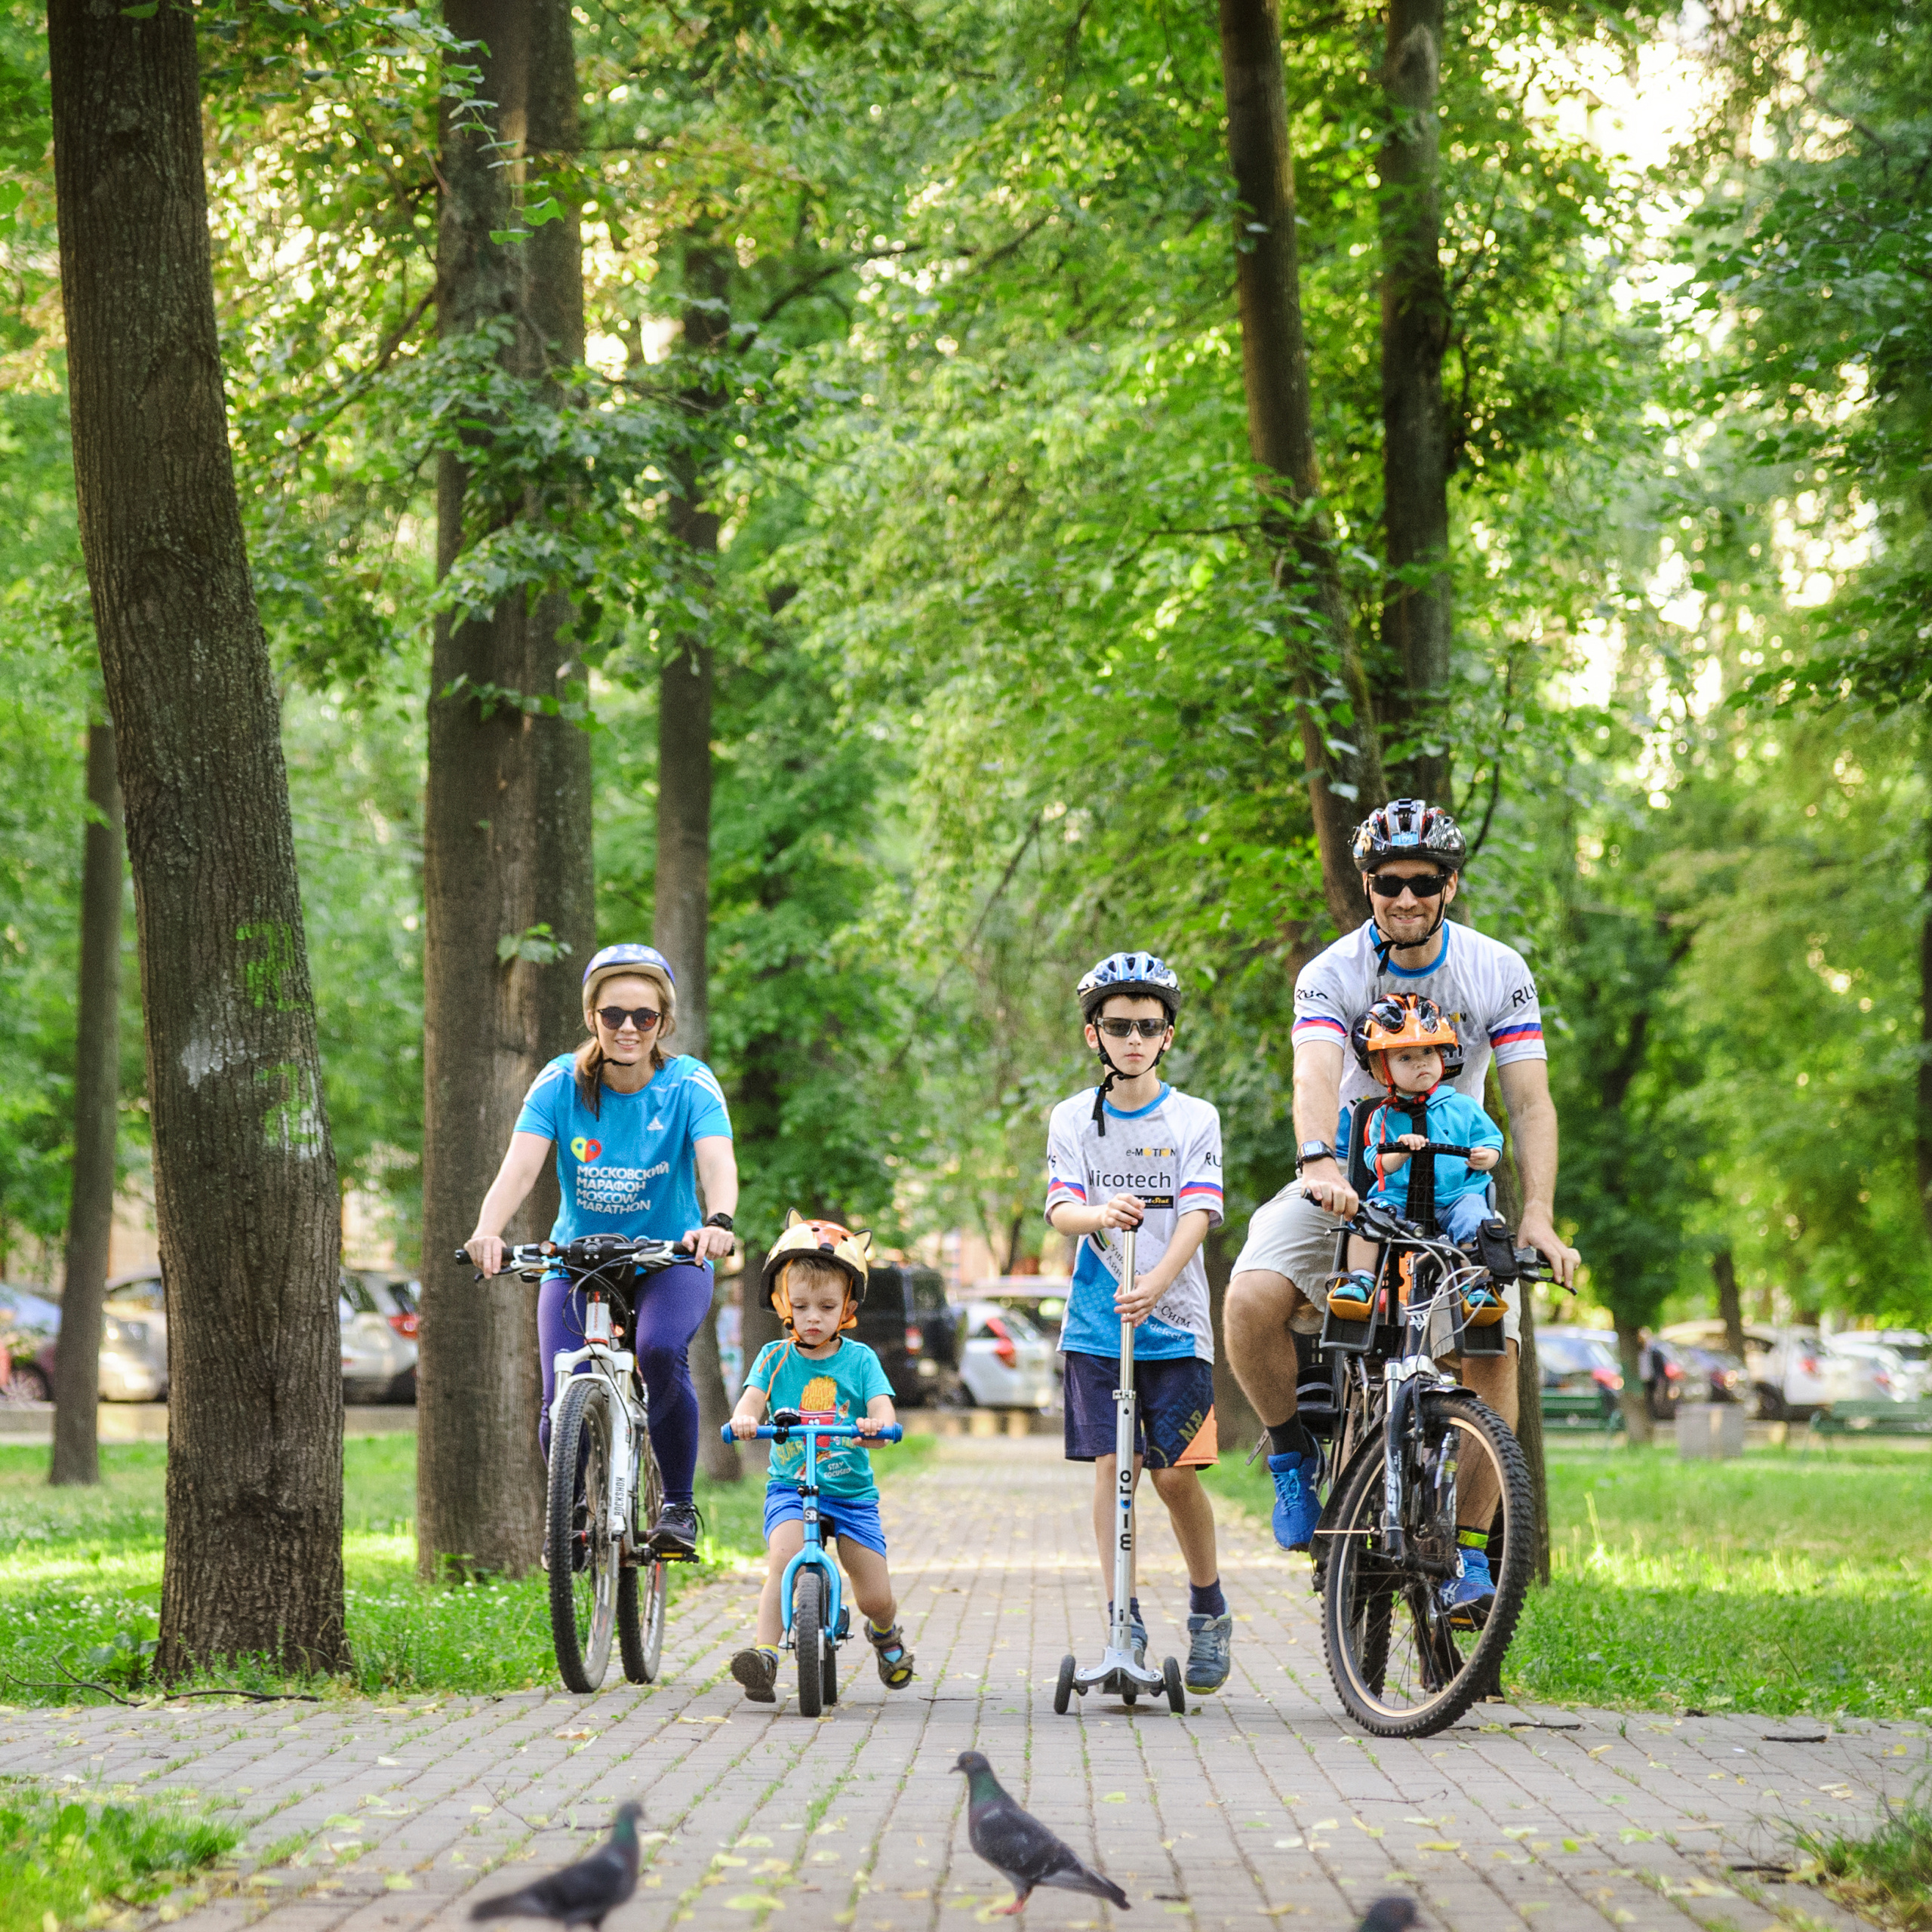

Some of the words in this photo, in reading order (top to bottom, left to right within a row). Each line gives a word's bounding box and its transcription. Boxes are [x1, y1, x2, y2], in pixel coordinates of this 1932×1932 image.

[577, 1161, 669, 1181] МОСКОВСКИЙ
[577, 1177, 646, 1192] МАРАФОН
[576, 1188, 638, 1204] MOSCOW
[576, 1198, 651, 1214] MARATHON
[827, 1461, 844, 1471] STAY
